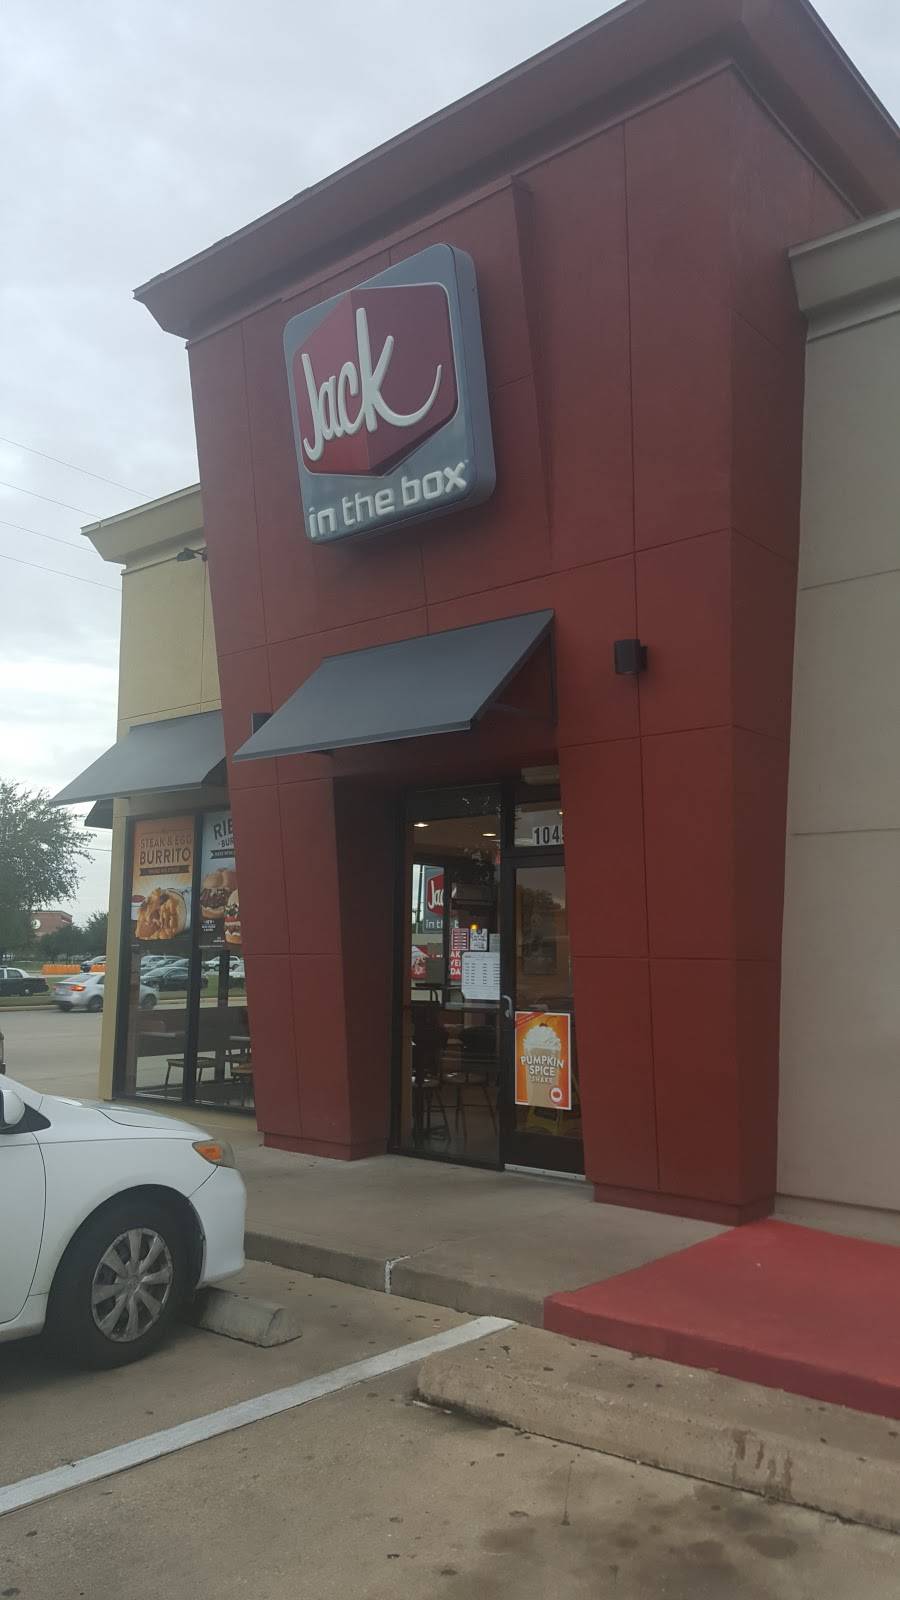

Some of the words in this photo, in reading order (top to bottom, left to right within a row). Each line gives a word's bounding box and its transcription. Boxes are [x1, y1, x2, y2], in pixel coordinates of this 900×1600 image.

[301, 307, 441, 461] Jack
[309, 506, 337, 538] in
[342, 488, 395, 526] the
[401, 462, 467, 506] box
[140, 838, 165, 849] STEAK
[534, 825, 564, 845] 104
[139, 847, 191, 865] BURRITO
[520, 1055, 564, 1068] PUMPKIN
[529, 1065, 556, 1076] SPICE
